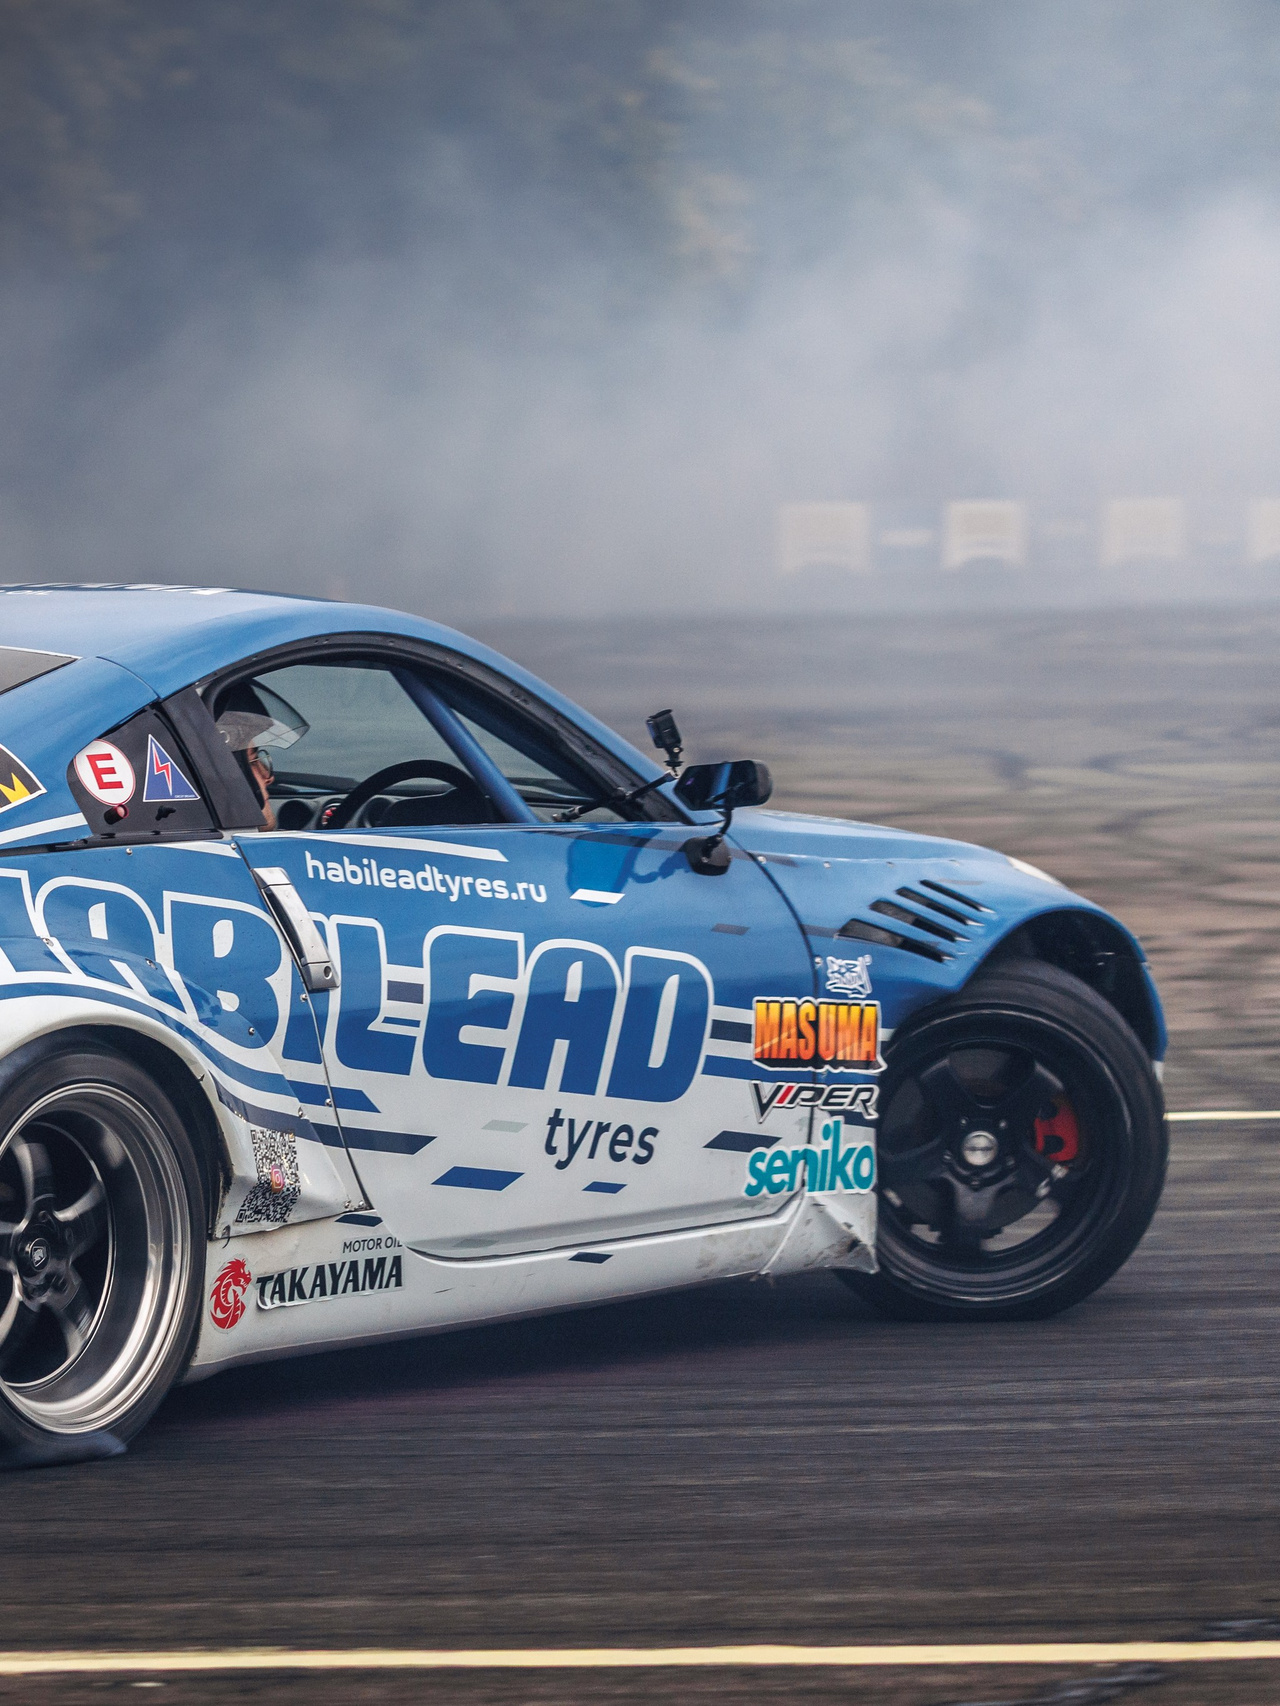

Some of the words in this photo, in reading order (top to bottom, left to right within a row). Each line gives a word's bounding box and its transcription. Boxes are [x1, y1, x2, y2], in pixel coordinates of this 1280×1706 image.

[86, 753, 123, 790] E
[305, 850, 547, 903] habileadtyres.ru
[754, 1000, 879, 1062] MASUMA
[750, 1080, 879, 1123] VIPER
[544, 1108, 660, 1170] tyres
[744, 1119, 875, 1197] seniko
[342, 1237, 382, 1254] MOTOR
[385, 1236, 403, 1249] OIL
[256, 1254, 403, 1306] TAKAYAMA
